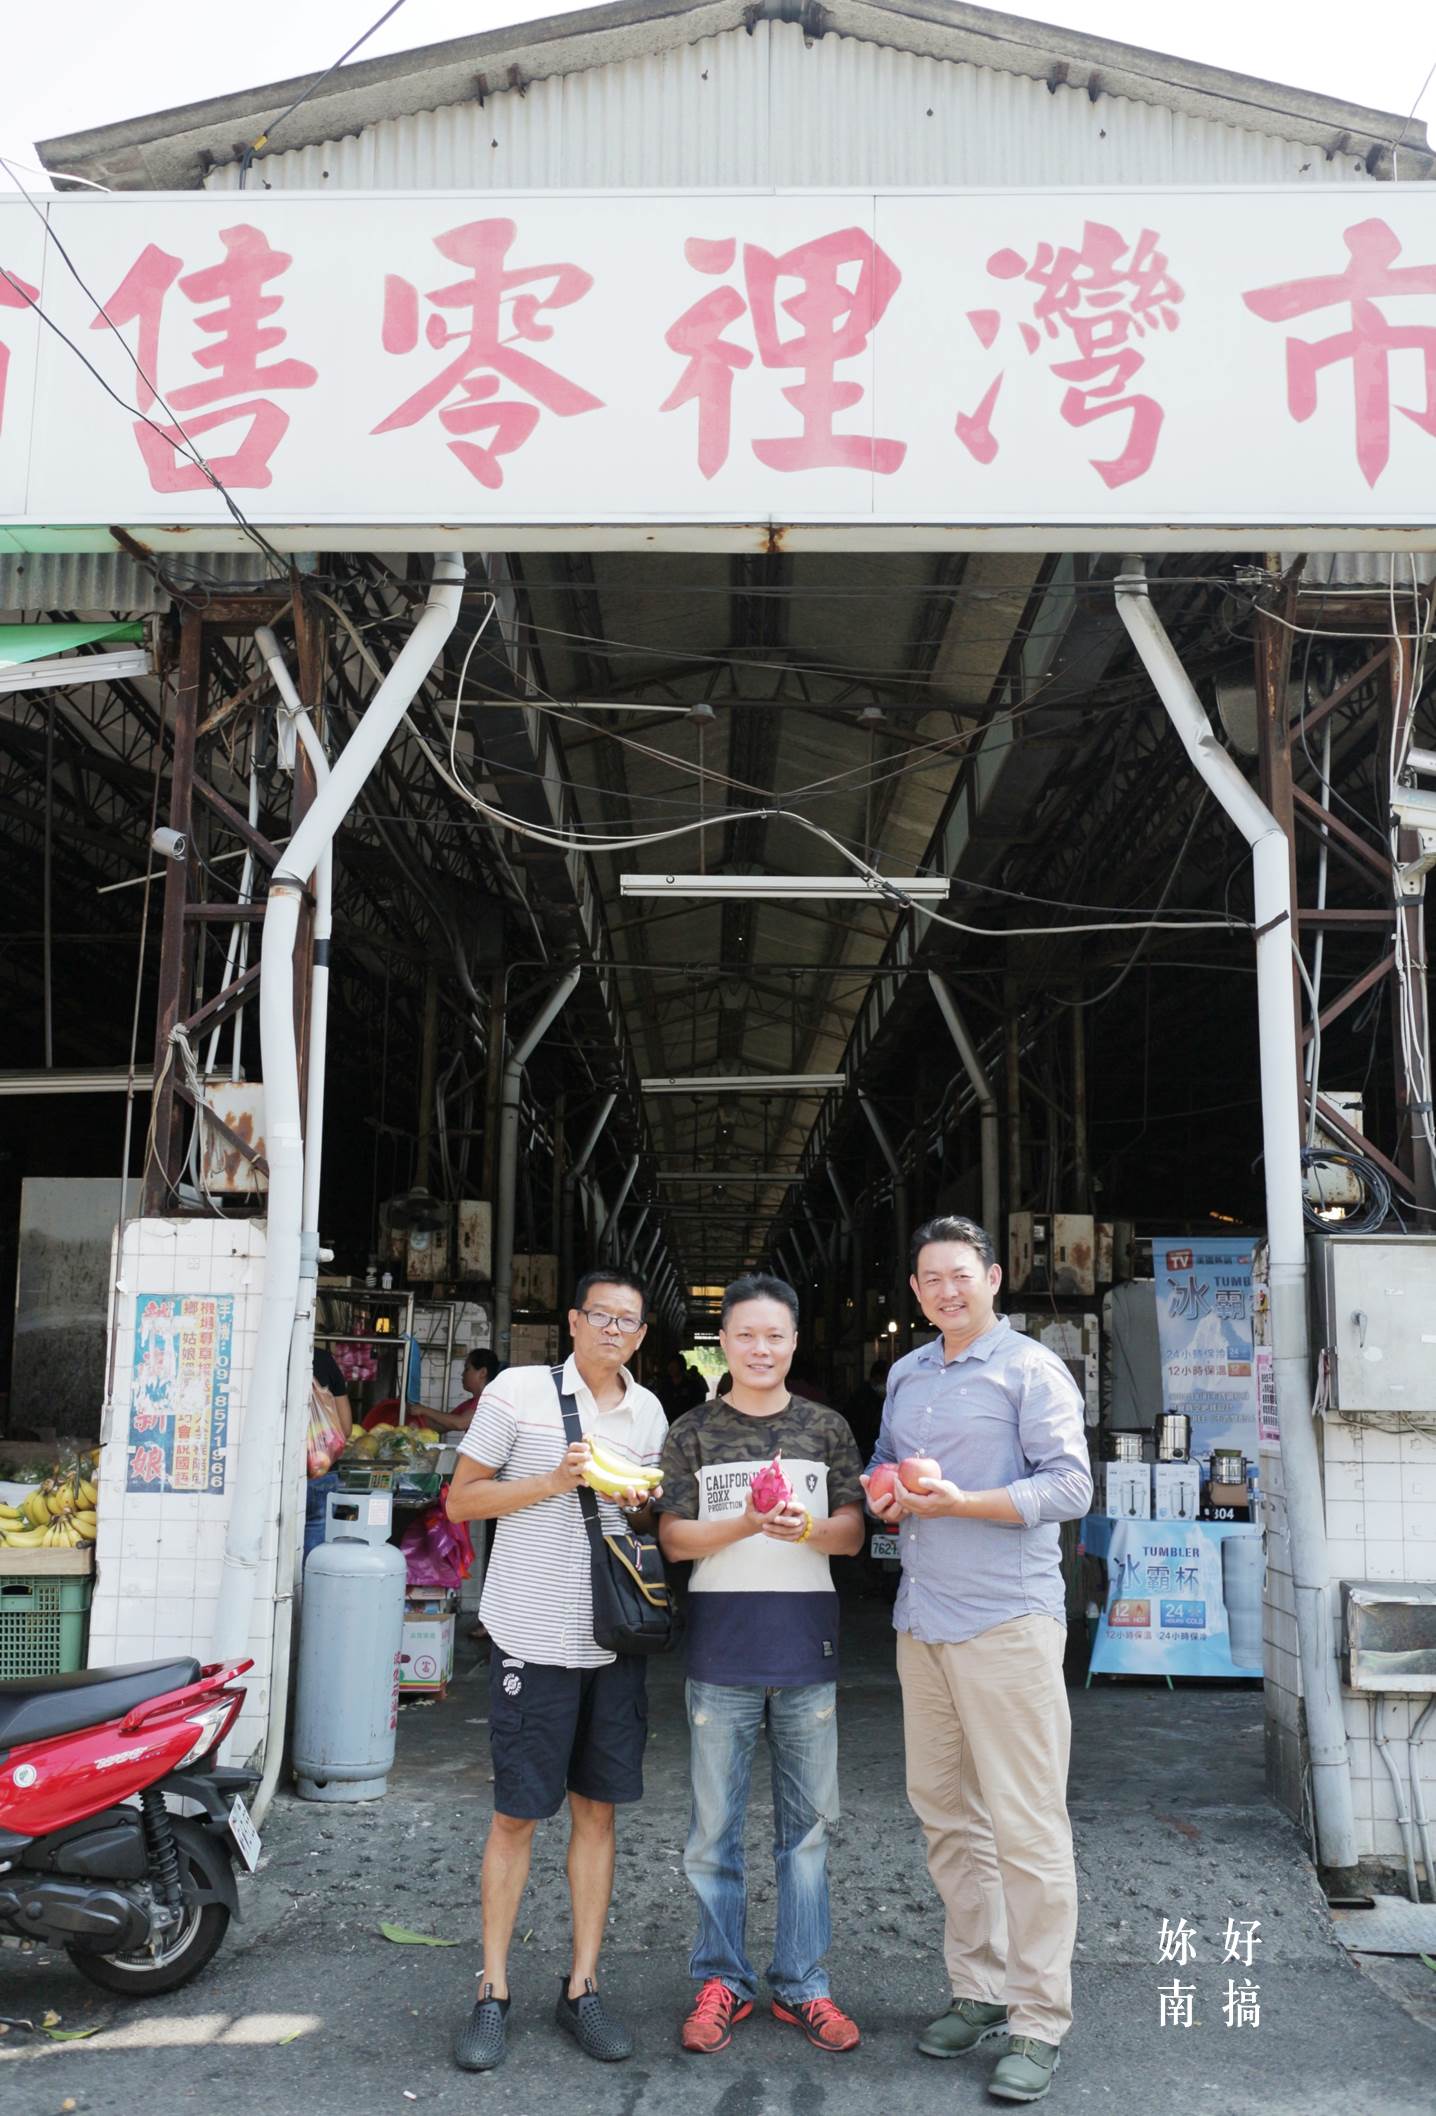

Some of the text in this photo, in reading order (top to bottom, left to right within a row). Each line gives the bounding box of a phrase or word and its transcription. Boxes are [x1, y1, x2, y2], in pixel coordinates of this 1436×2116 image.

[708, 1501, 743, 1512] PRODUCTION
[1143, 1547, 1200, 1558] TUMBLER
[1114, 1602, 1129, 1617] 12
[1166, 1603, 1184, 1617] 24
